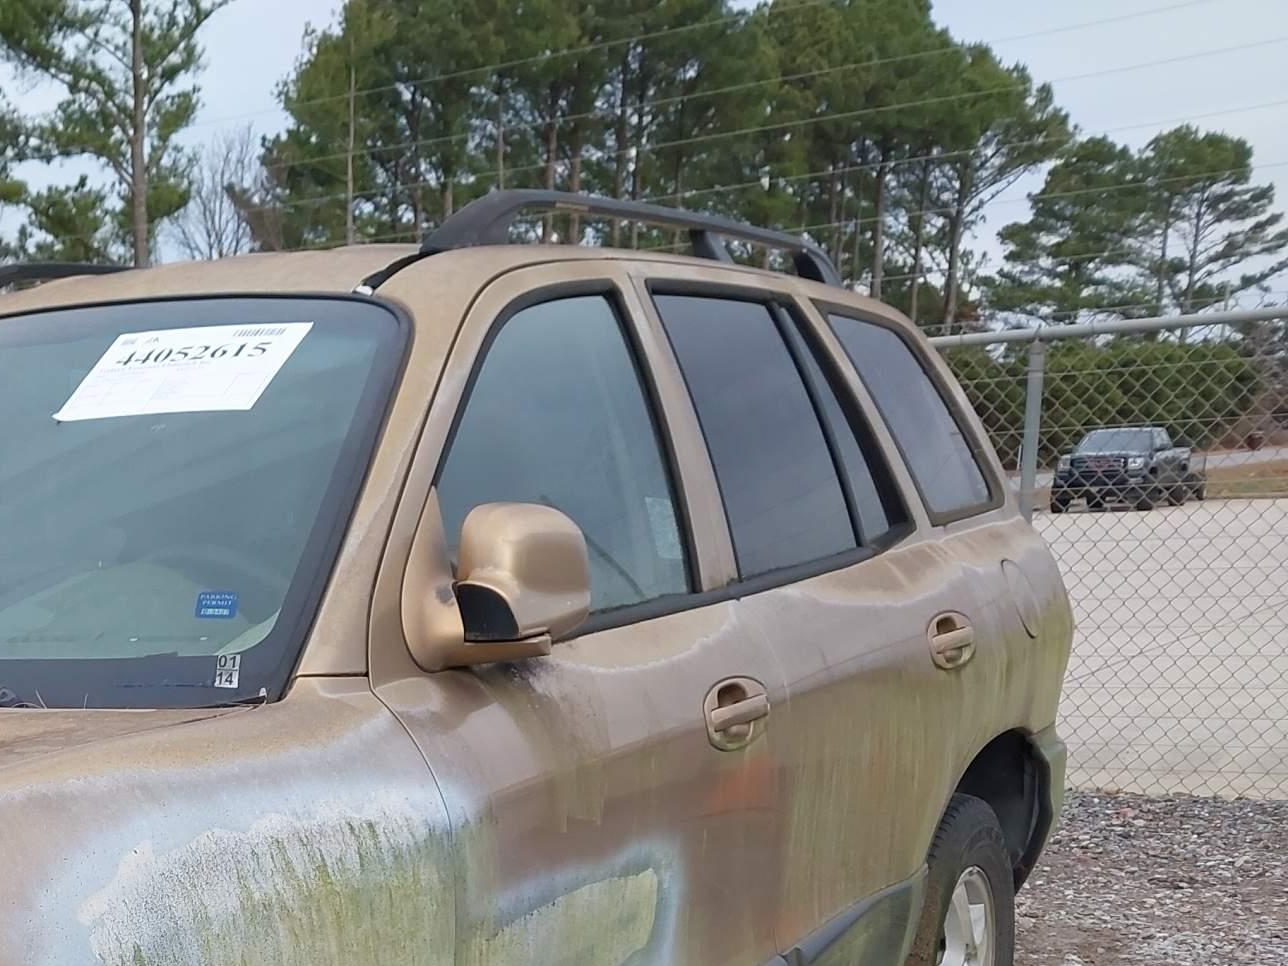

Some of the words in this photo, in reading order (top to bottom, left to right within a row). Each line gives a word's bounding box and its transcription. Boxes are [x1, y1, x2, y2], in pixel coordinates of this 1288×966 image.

[116, 341, 272, 367] 44052615
[218, 655, 236, 668] 01
[217, 671, 234, 685] 14
